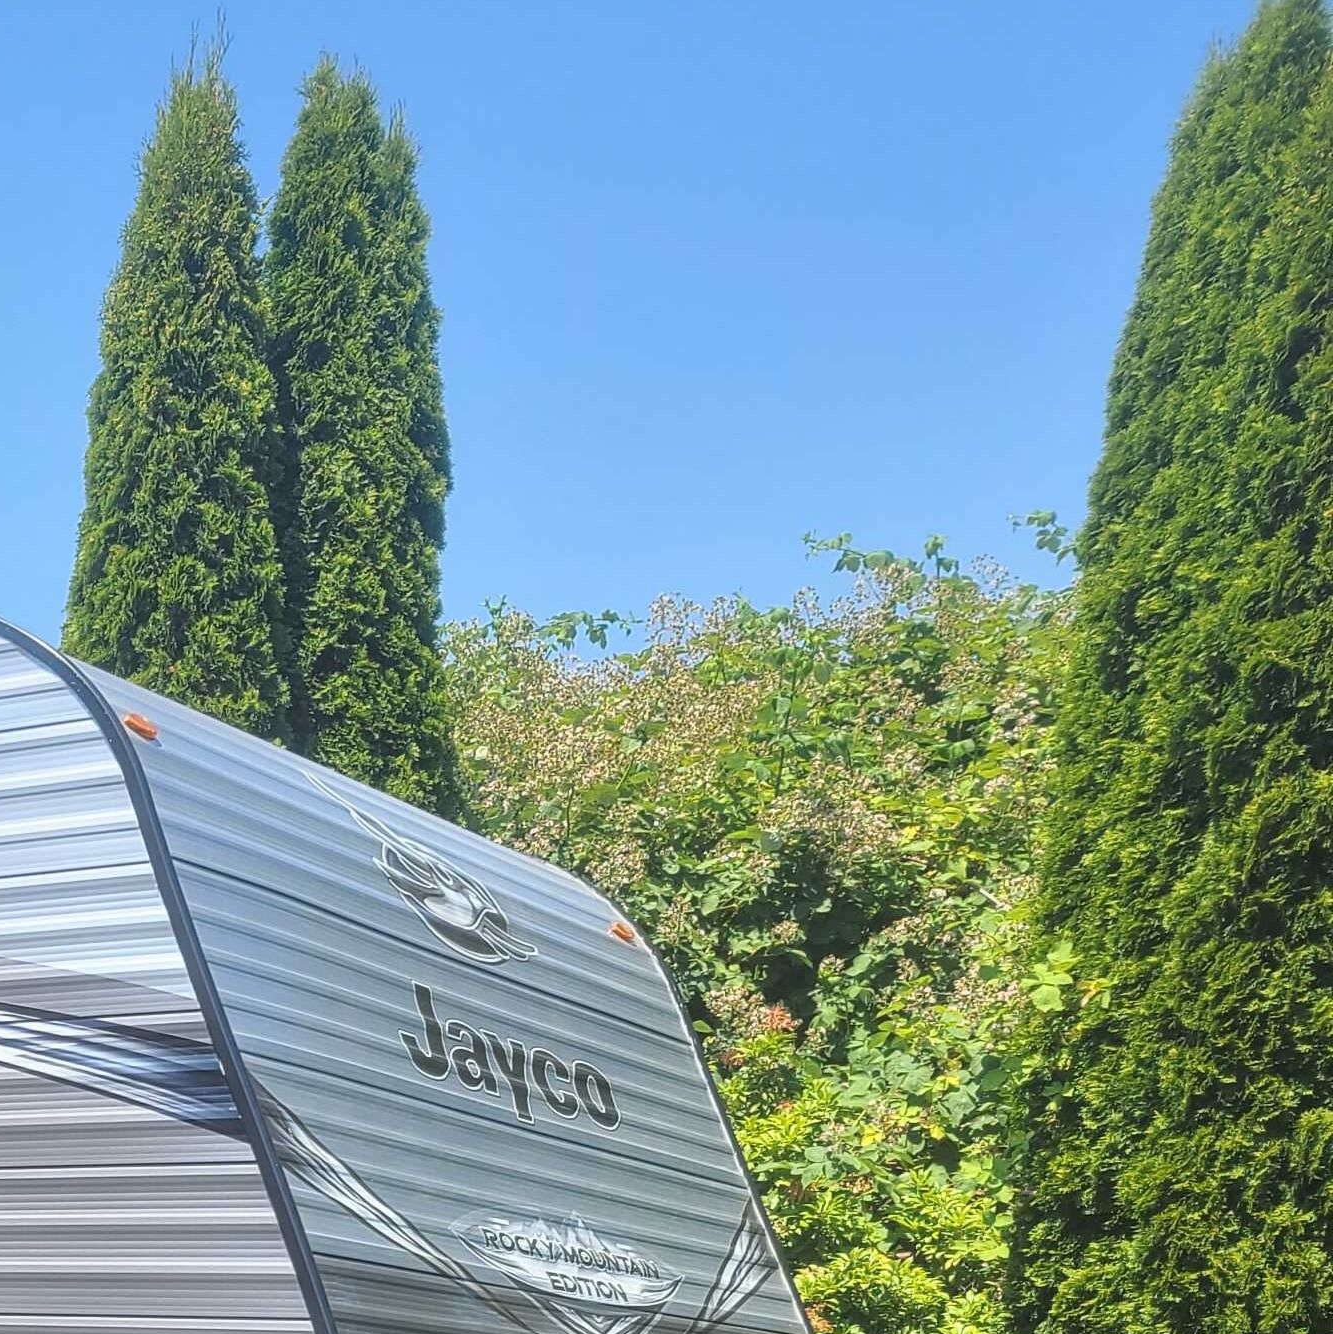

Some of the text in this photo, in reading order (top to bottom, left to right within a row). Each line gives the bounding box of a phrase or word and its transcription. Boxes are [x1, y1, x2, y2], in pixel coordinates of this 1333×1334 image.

[398, 979, 621, 1131] Jayco
[483, 1228, 660, 1280] ROCKY MOUNTAIN
[546, 1271, 629, 1302] EDITION
